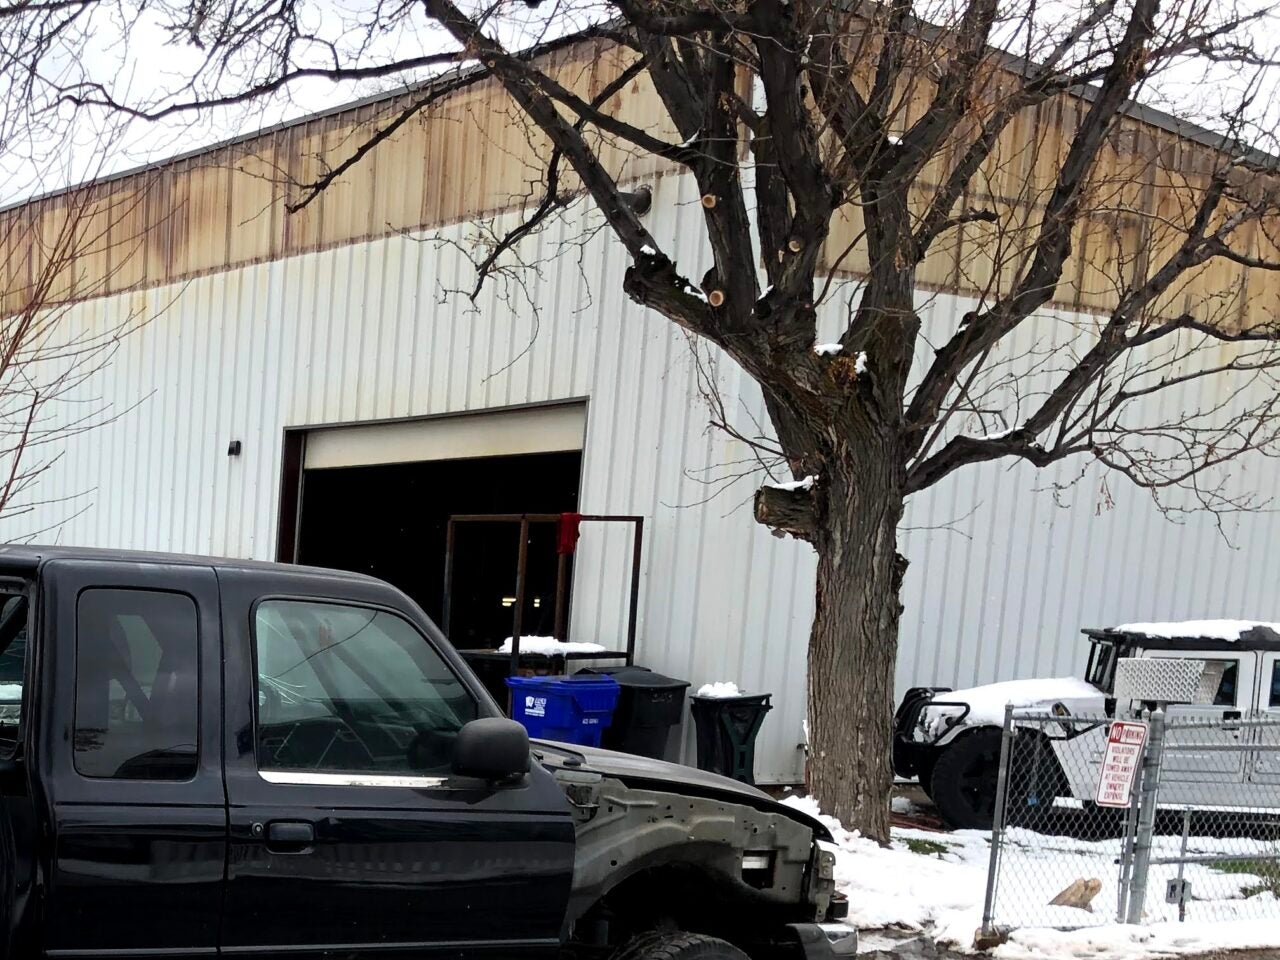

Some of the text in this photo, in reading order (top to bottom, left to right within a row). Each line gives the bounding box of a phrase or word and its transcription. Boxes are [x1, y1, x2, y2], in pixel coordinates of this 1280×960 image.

[1111, 726, 1143, 741] NO PARKING
[1106, 764, 1120, 772] TOWED
